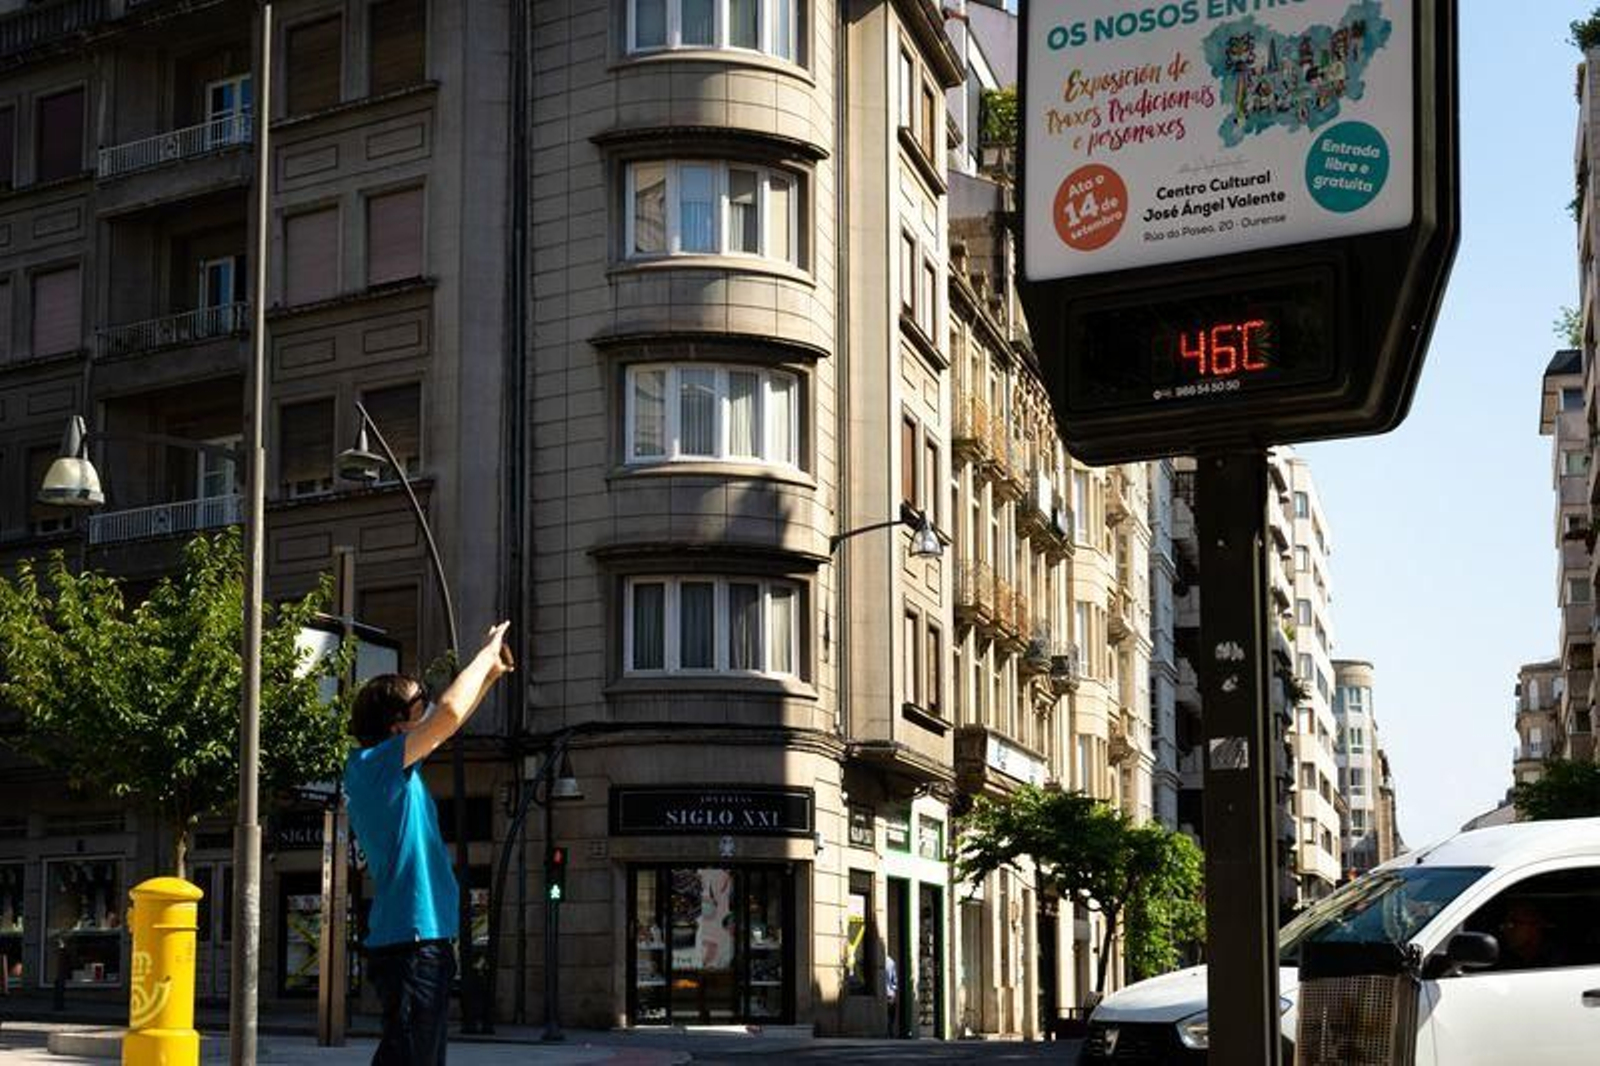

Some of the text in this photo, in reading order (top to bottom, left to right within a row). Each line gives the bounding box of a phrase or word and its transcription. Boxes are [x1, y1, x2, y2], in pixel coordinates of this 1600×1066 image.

[1047, 22, 1088, 50] OS
[1094, 0, 1200, 42] NOSOS
[1064, 52, 1190, 102] Exposición de
[1073, 117, 1186, 156] e personaxes
[1321, 138, 1381, 159] Entrada
[1095, 174, 1105, 185] o
[1324, 156, 1370, 175] libre e
[1156, 169, 1271, 201] Centro Cultural
[1312, 174, 1374, 193] gratuita
[1063, 190, 1119, 228] 14 de
[1142, 189, 1287, 223] José Ángel Valente
[1070, 210, 1123, 240] setembro
[1143, 230, 1165, 242] Rúa
[1167, 227, 1180, 239] do
[1218, 218, 1235, 232] 20
[1240, 213, 1287, 229] Ourense
[665, 808, 780, 828] SIGLO XXI
